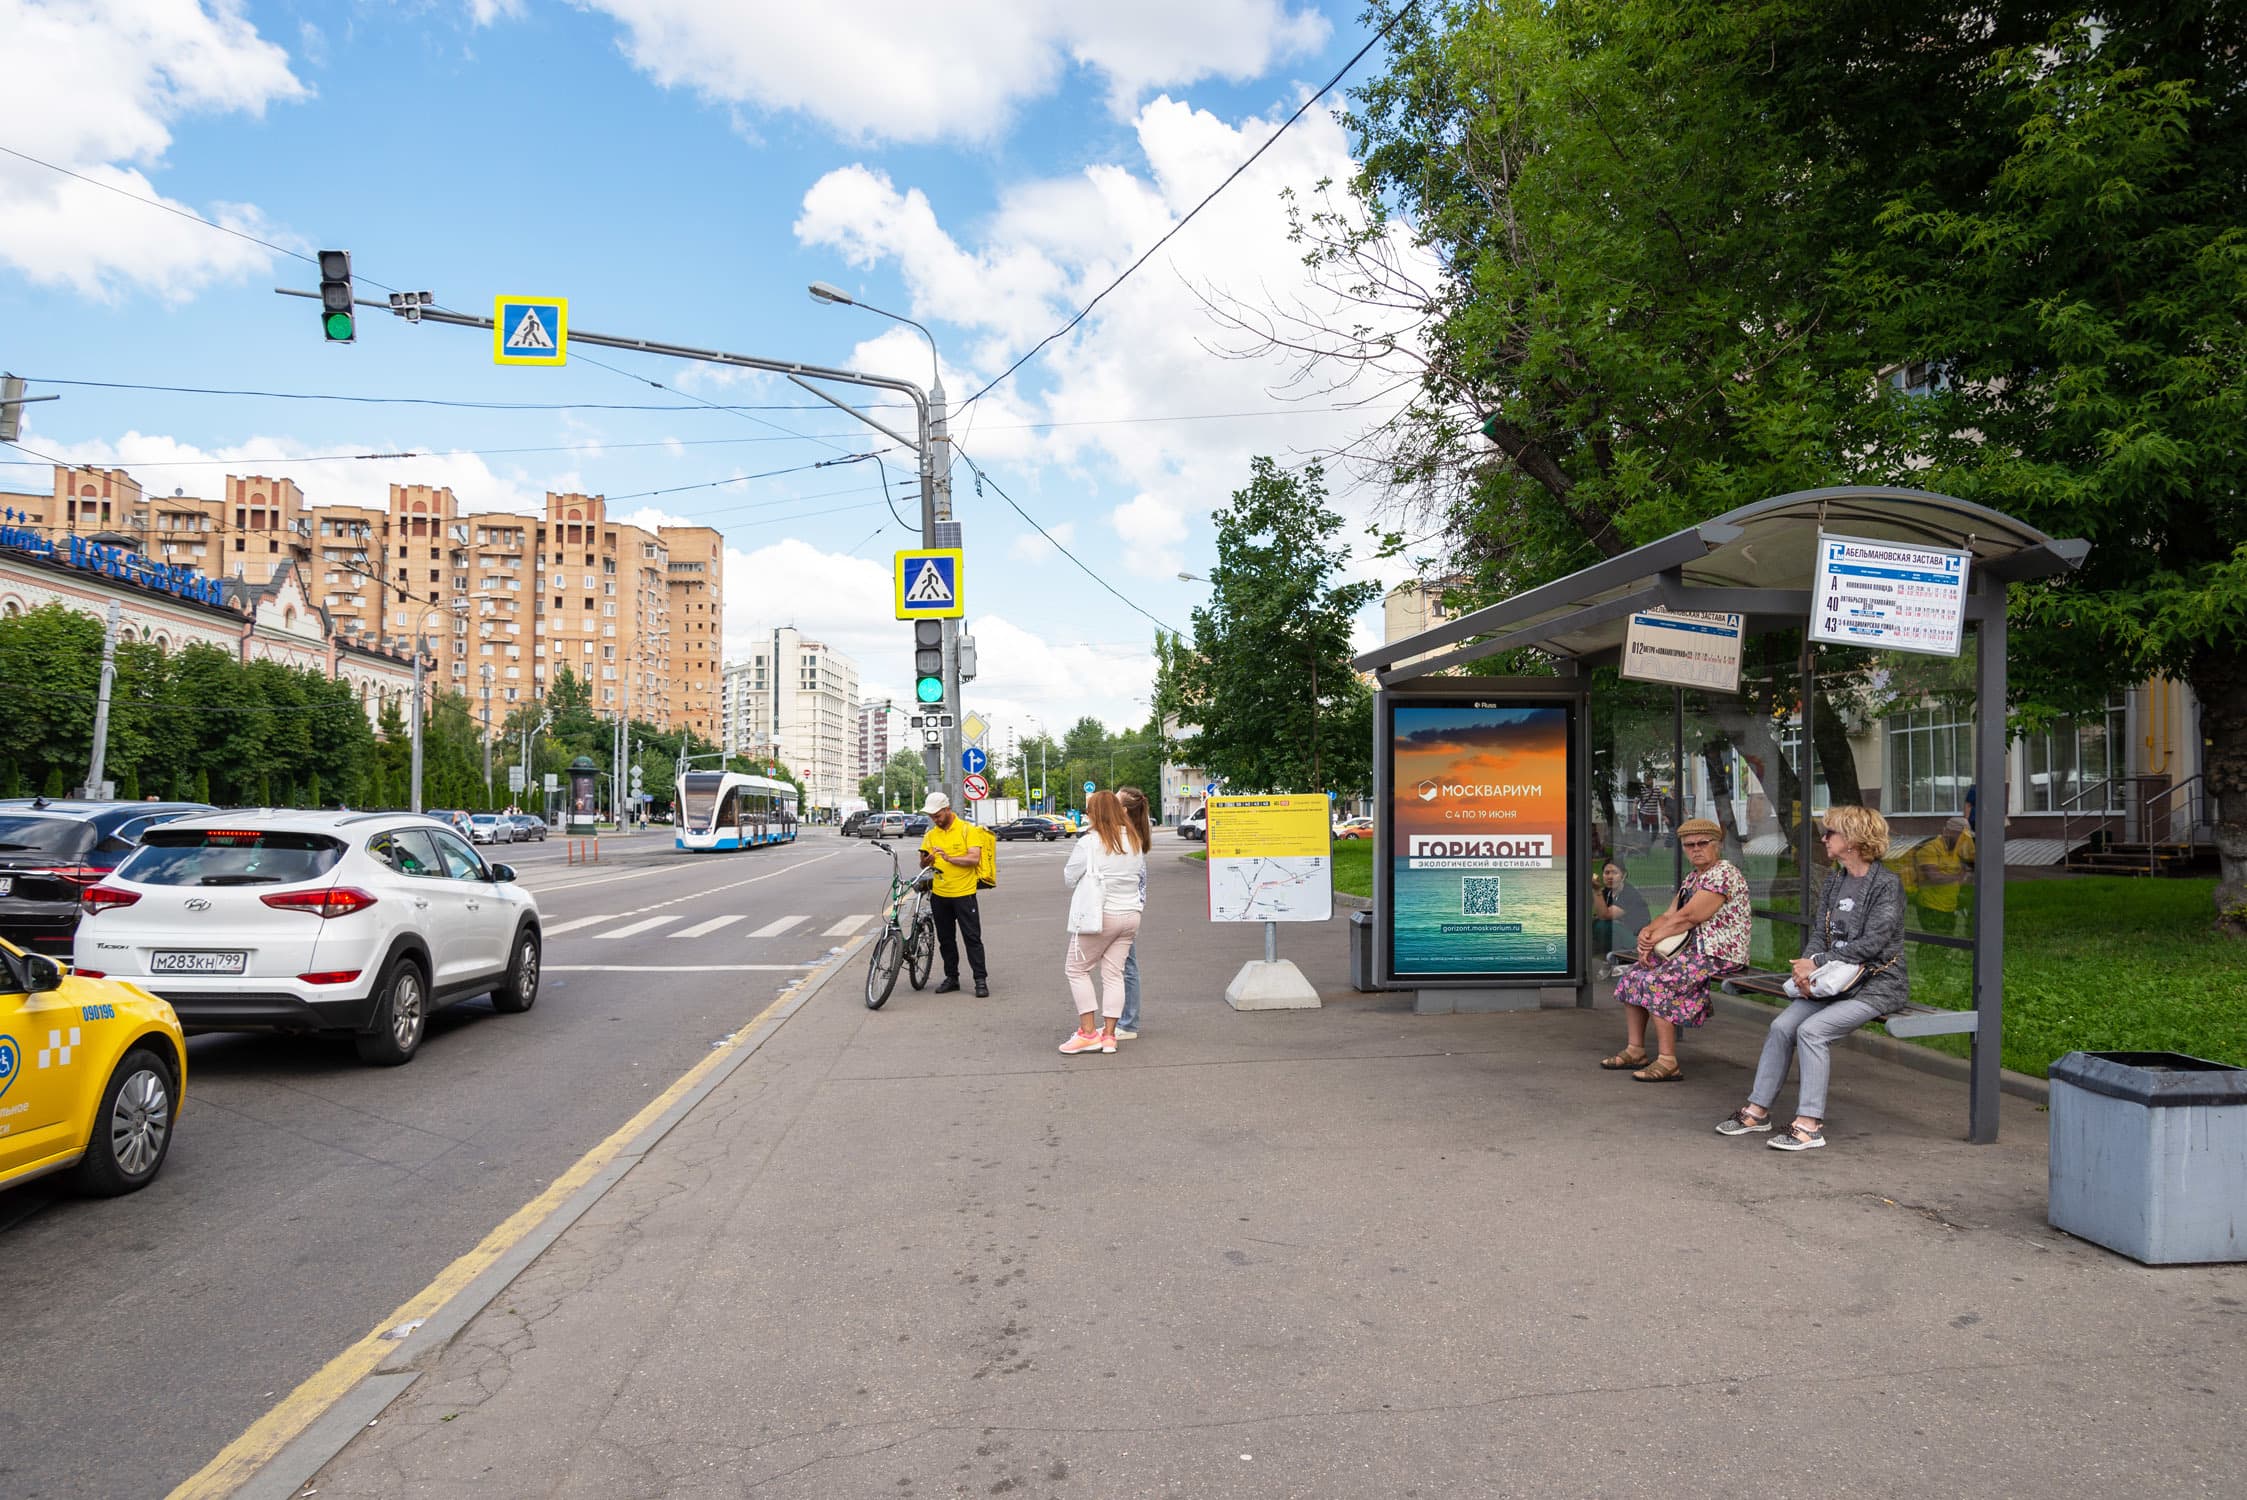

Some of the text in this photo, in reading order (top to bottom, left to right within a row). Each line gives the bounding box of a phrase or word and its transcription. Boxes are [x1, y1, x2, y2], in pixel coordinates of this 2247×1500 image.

[1845, 548, 1944, 565] АБЕЛЬМАНОВСКАЯ ЗАСТАВА
[1831, 576, 1838, 591] А
[1826, 596, 1839, 612] 40
[1701, 611, 1726, 622] ЗАСТАВА
[1824, 617, 1837, 633] 43
[1442, 785, 1542, 797] МОСКВАРИУМ
[1445, 810, 1517, 819] С 4 ПО 19 ИЮНЯ
[1418, 841, 1544, 857] ГОРИЗОНТ
[1418, 860, 1541, 868] ЭКОЛОГИЧЕСКИЙ ФЕСТИВАЛЬ
[1442, 924, 1520, 933] gorizont.moskvarium.ru
[218, 954, 240, 965] 799
[82, 1004, 115, 1022] 090196
